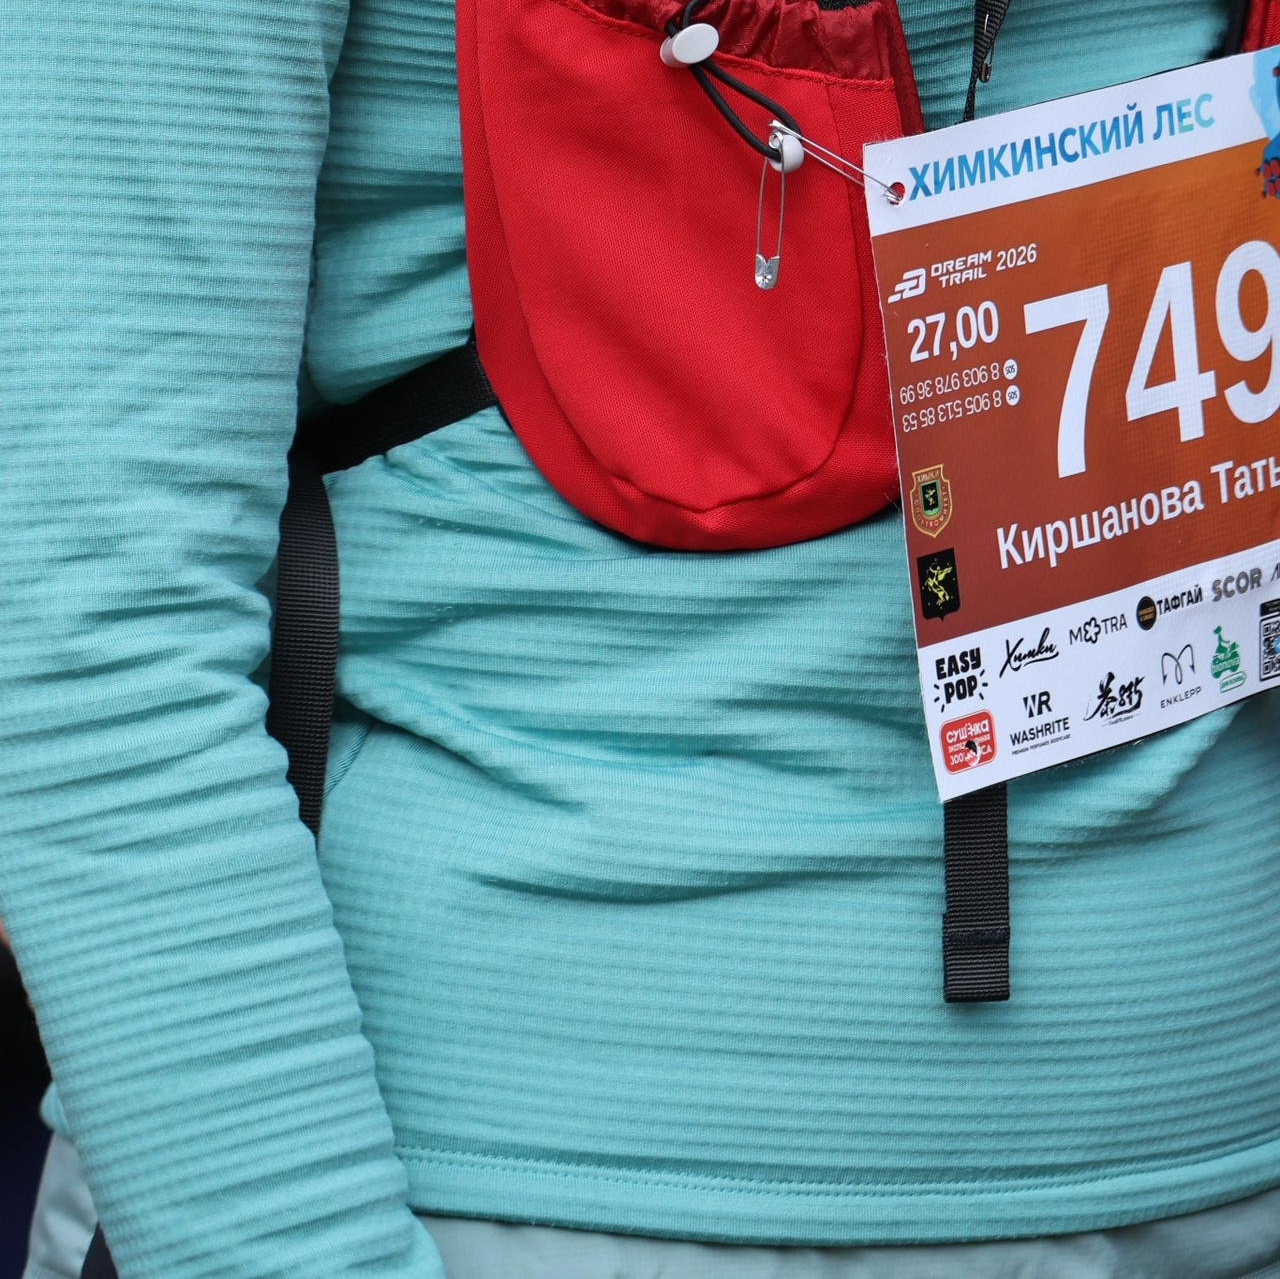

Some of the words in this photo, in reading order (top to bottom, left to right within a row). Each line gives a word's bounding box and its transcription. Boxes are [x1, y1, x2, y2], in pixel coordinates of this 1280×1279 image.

[908, 102, 1144, 201] ХИМКИНСКИЙ
[1152, 93, 1215, 141] ЛЕС
[931, 250, 992, 278] DREAM
[996, 243, 1037, 272] 2026
[939, 267, 987, 288] TRAIL
[907, 300, 999, 363] 27,00
[962, 365, 988, 387] 903
[990, 362, 1000, 380] 8
[900, 385, 915, 405] 99
[917, 379, 933, 400] 36
[935, 372, 960, 395] 978
[965, 393, 991, 415] 905
[992, 389, 1002, 408] 8
[902, 412, 918, 433] 53
[919, 407, 936, 428] 85
[938, 400, 963, 422] 513
[996, 479, 1205, 570] Киршанова
[1211, 567, 1262, 603] SCOR
[1156, 584, 1203, 616] ТАФГАЙ
[935, 647, 981, 680] EASY
[944, 675, 978, 704] POP
[1160, 686, 1202, 709] ENKLEPP
[1009, 717, 1070, 746] WASHRITE
